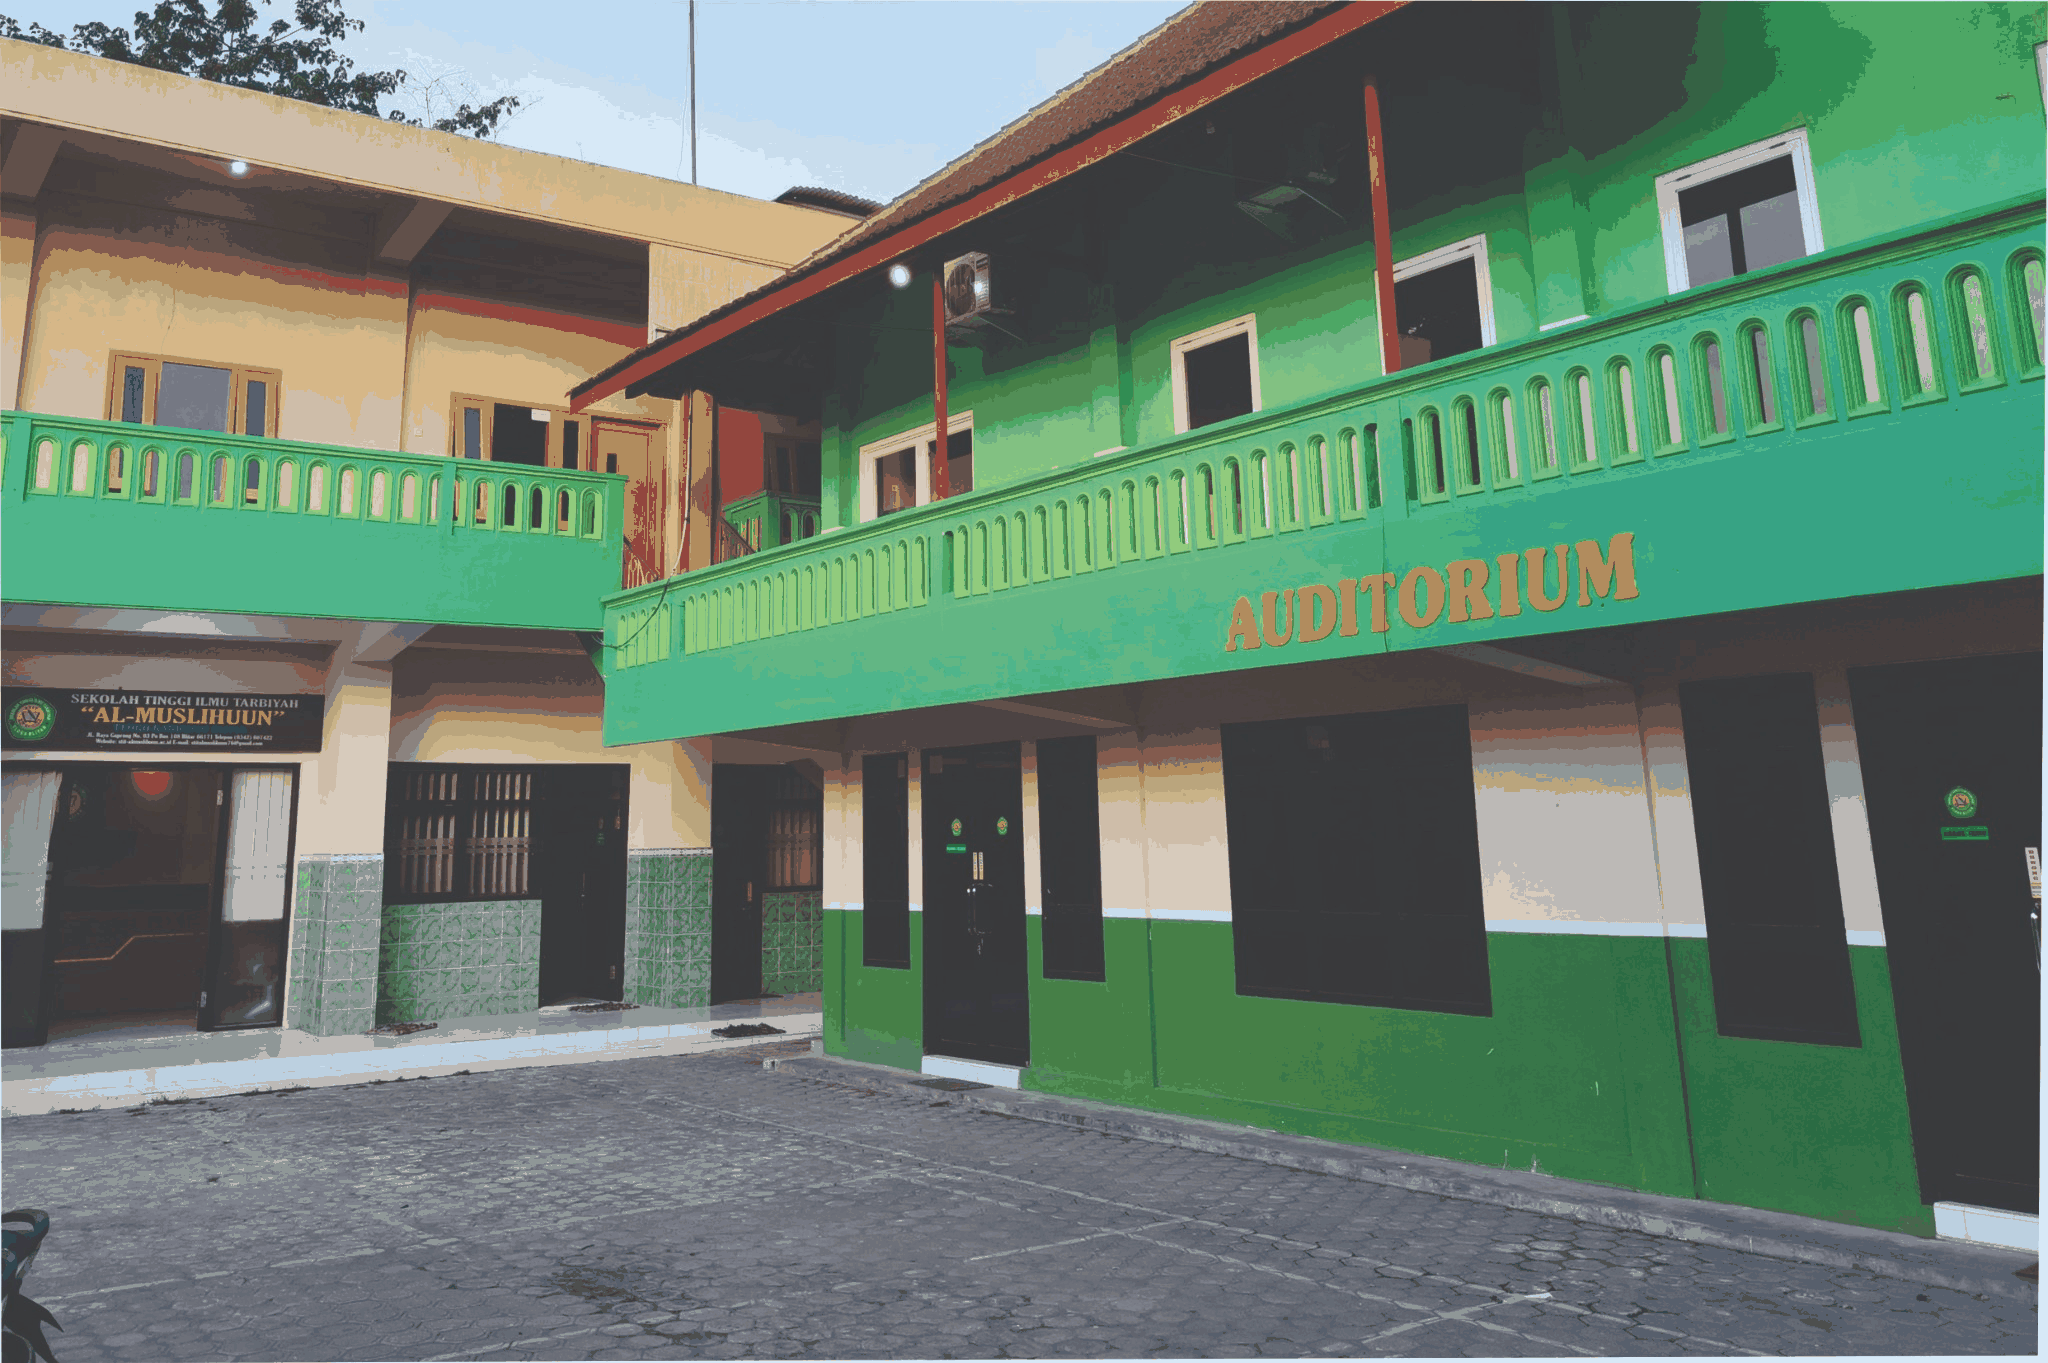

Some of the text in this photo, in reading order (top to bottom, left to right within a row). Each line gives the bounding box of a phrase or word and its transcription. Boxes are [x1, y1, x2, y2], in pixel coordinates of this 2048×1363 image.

[1225, 532, 1640, 652] AUDITORIUM
[71, 693, 299, 708] SEKOLAH TINGGI ILMU TARBIYAH
